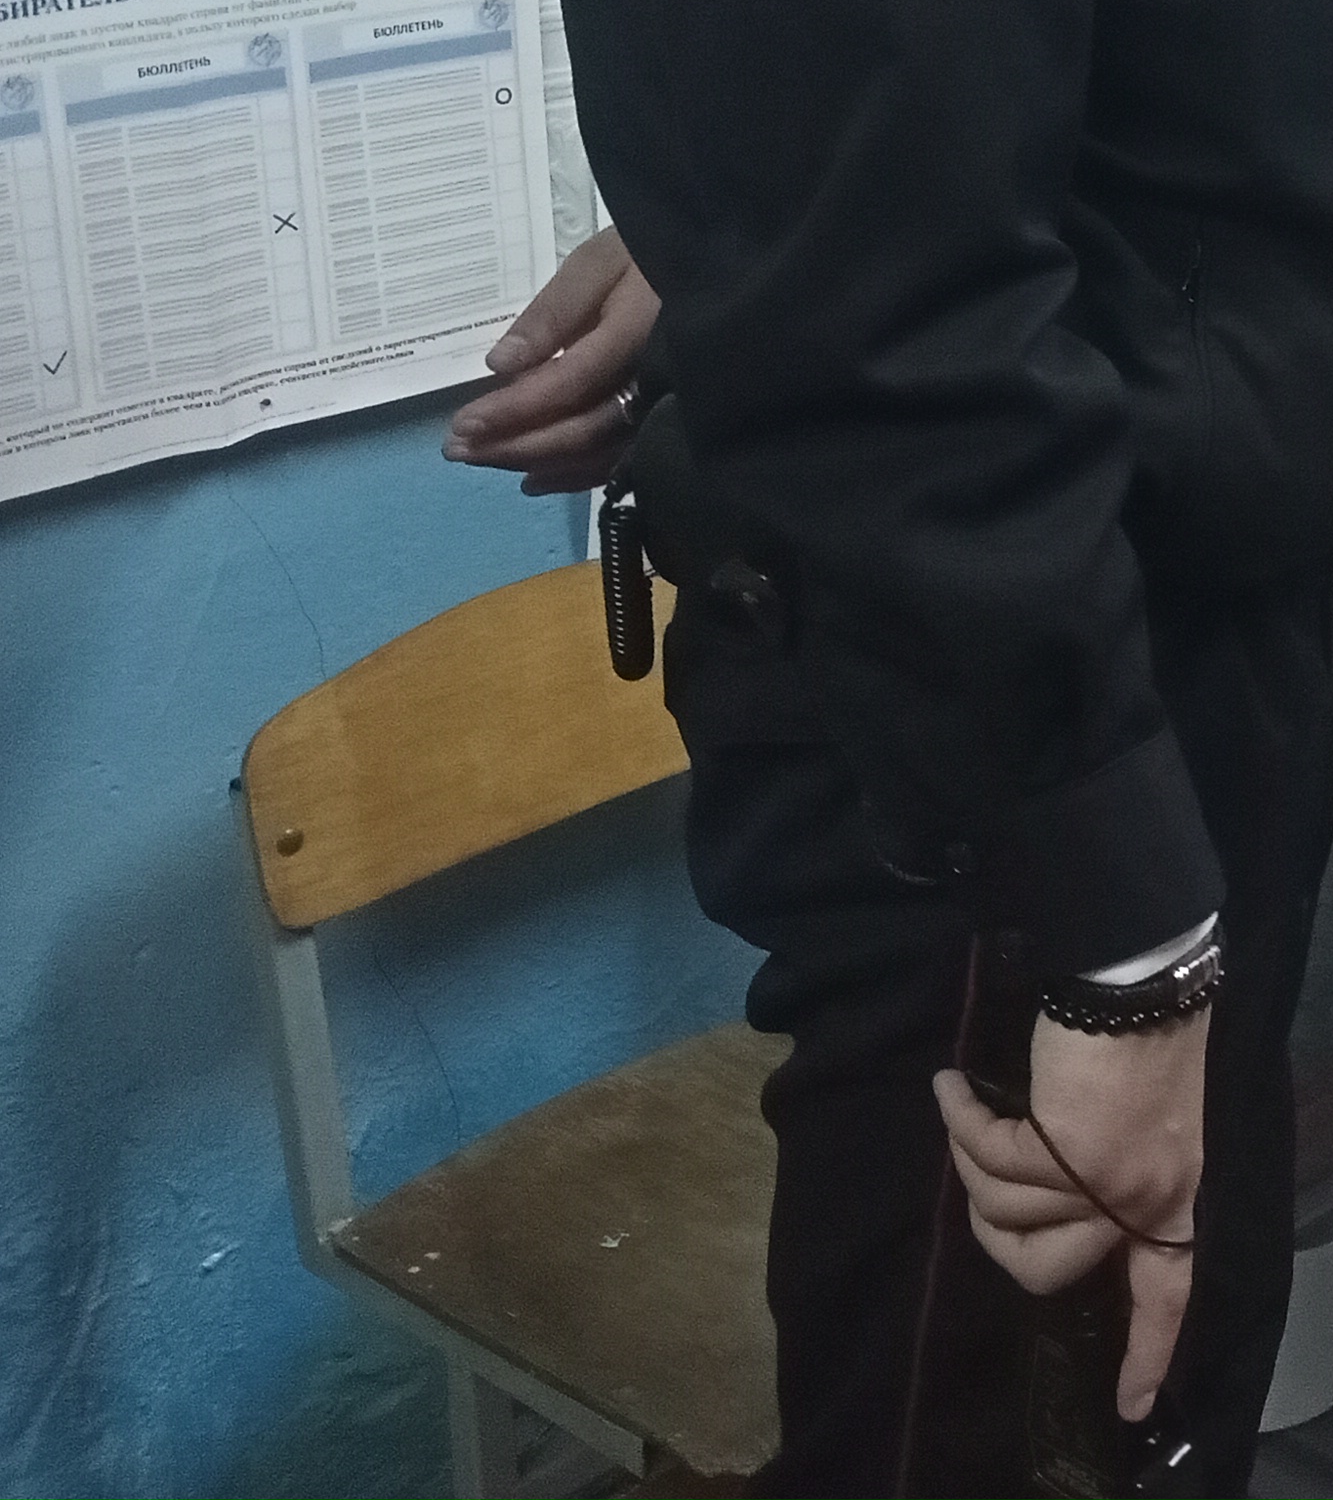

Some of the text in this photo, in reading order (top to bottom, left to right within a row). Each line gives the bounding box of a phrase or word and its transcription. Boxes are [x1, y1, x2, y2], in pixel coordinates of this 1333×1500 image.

[90, 20, 135, 39] пустом
[372, 18, 445, 40] БЮЛЛЕТЕНЬ
[137, 56, 212, 79] БЮЛЛЕТЕНЬ
